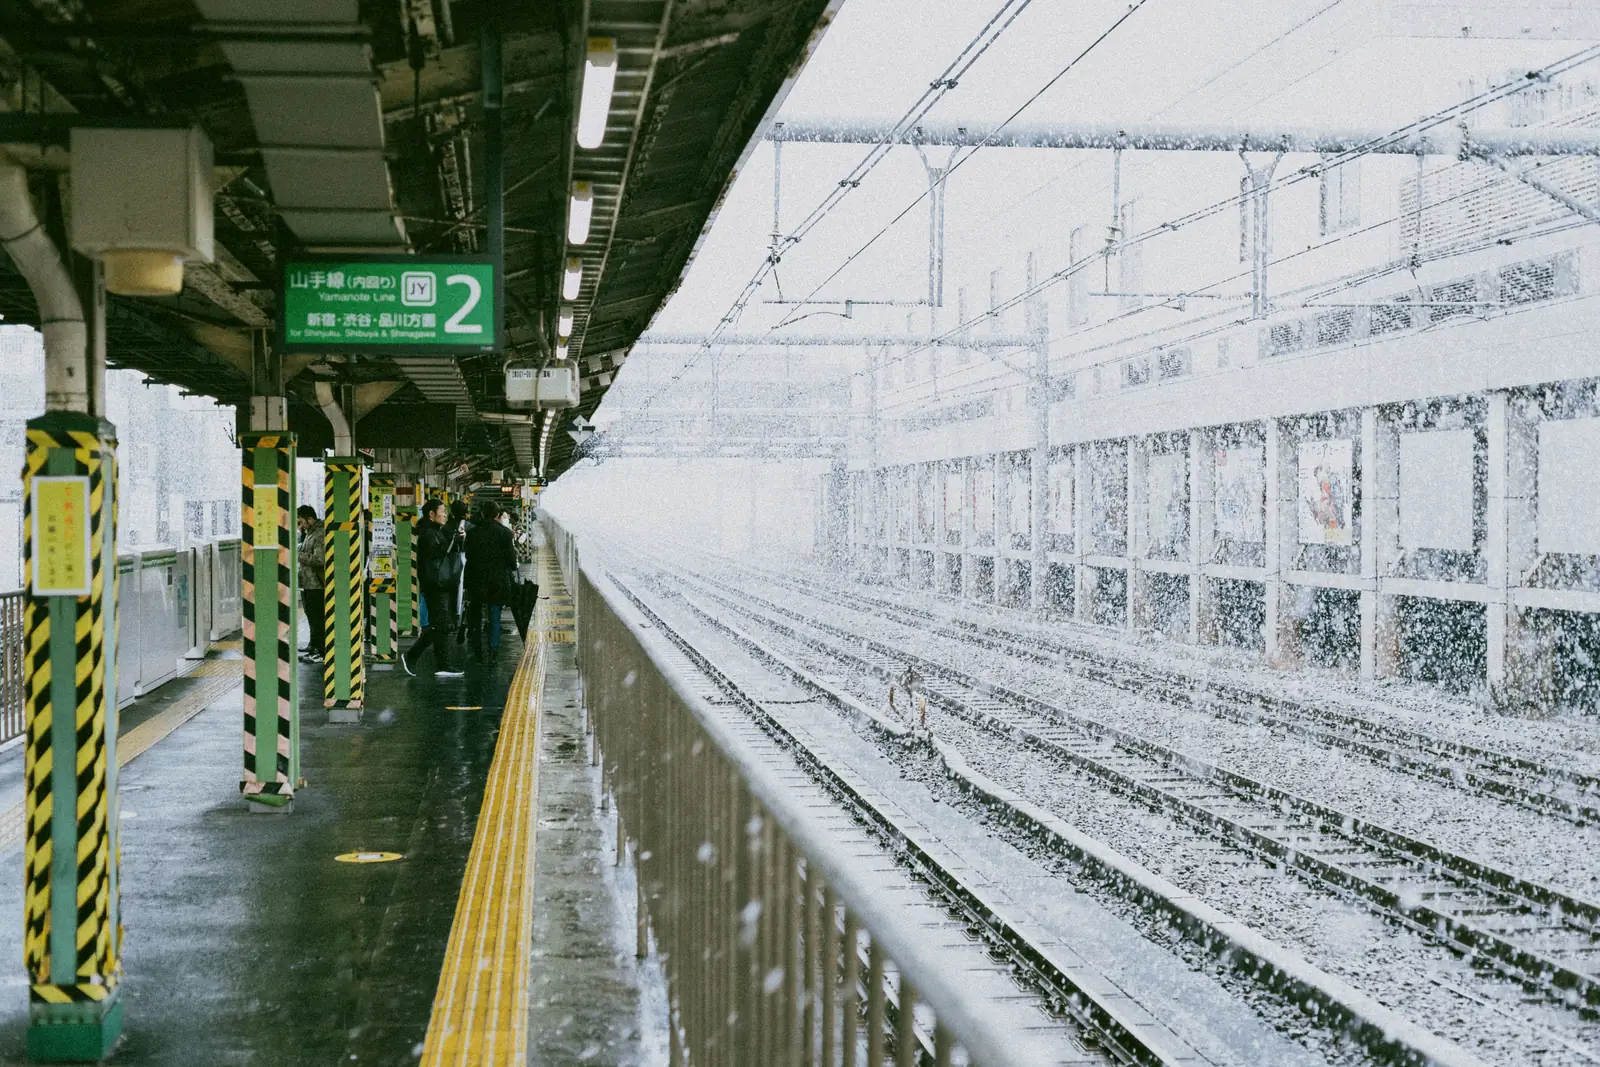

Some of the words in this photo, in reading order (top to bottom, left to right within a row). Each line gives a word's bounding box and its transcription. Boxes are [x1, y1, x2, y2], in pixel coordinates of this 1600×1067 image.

[410, 282, 427, 295] JY
[319, 293, 370, 302] Yamanote
[373, 293, 396, 302] Line
[444, 274, 483, 334] 2
[541, 478, 547, 486] 2
